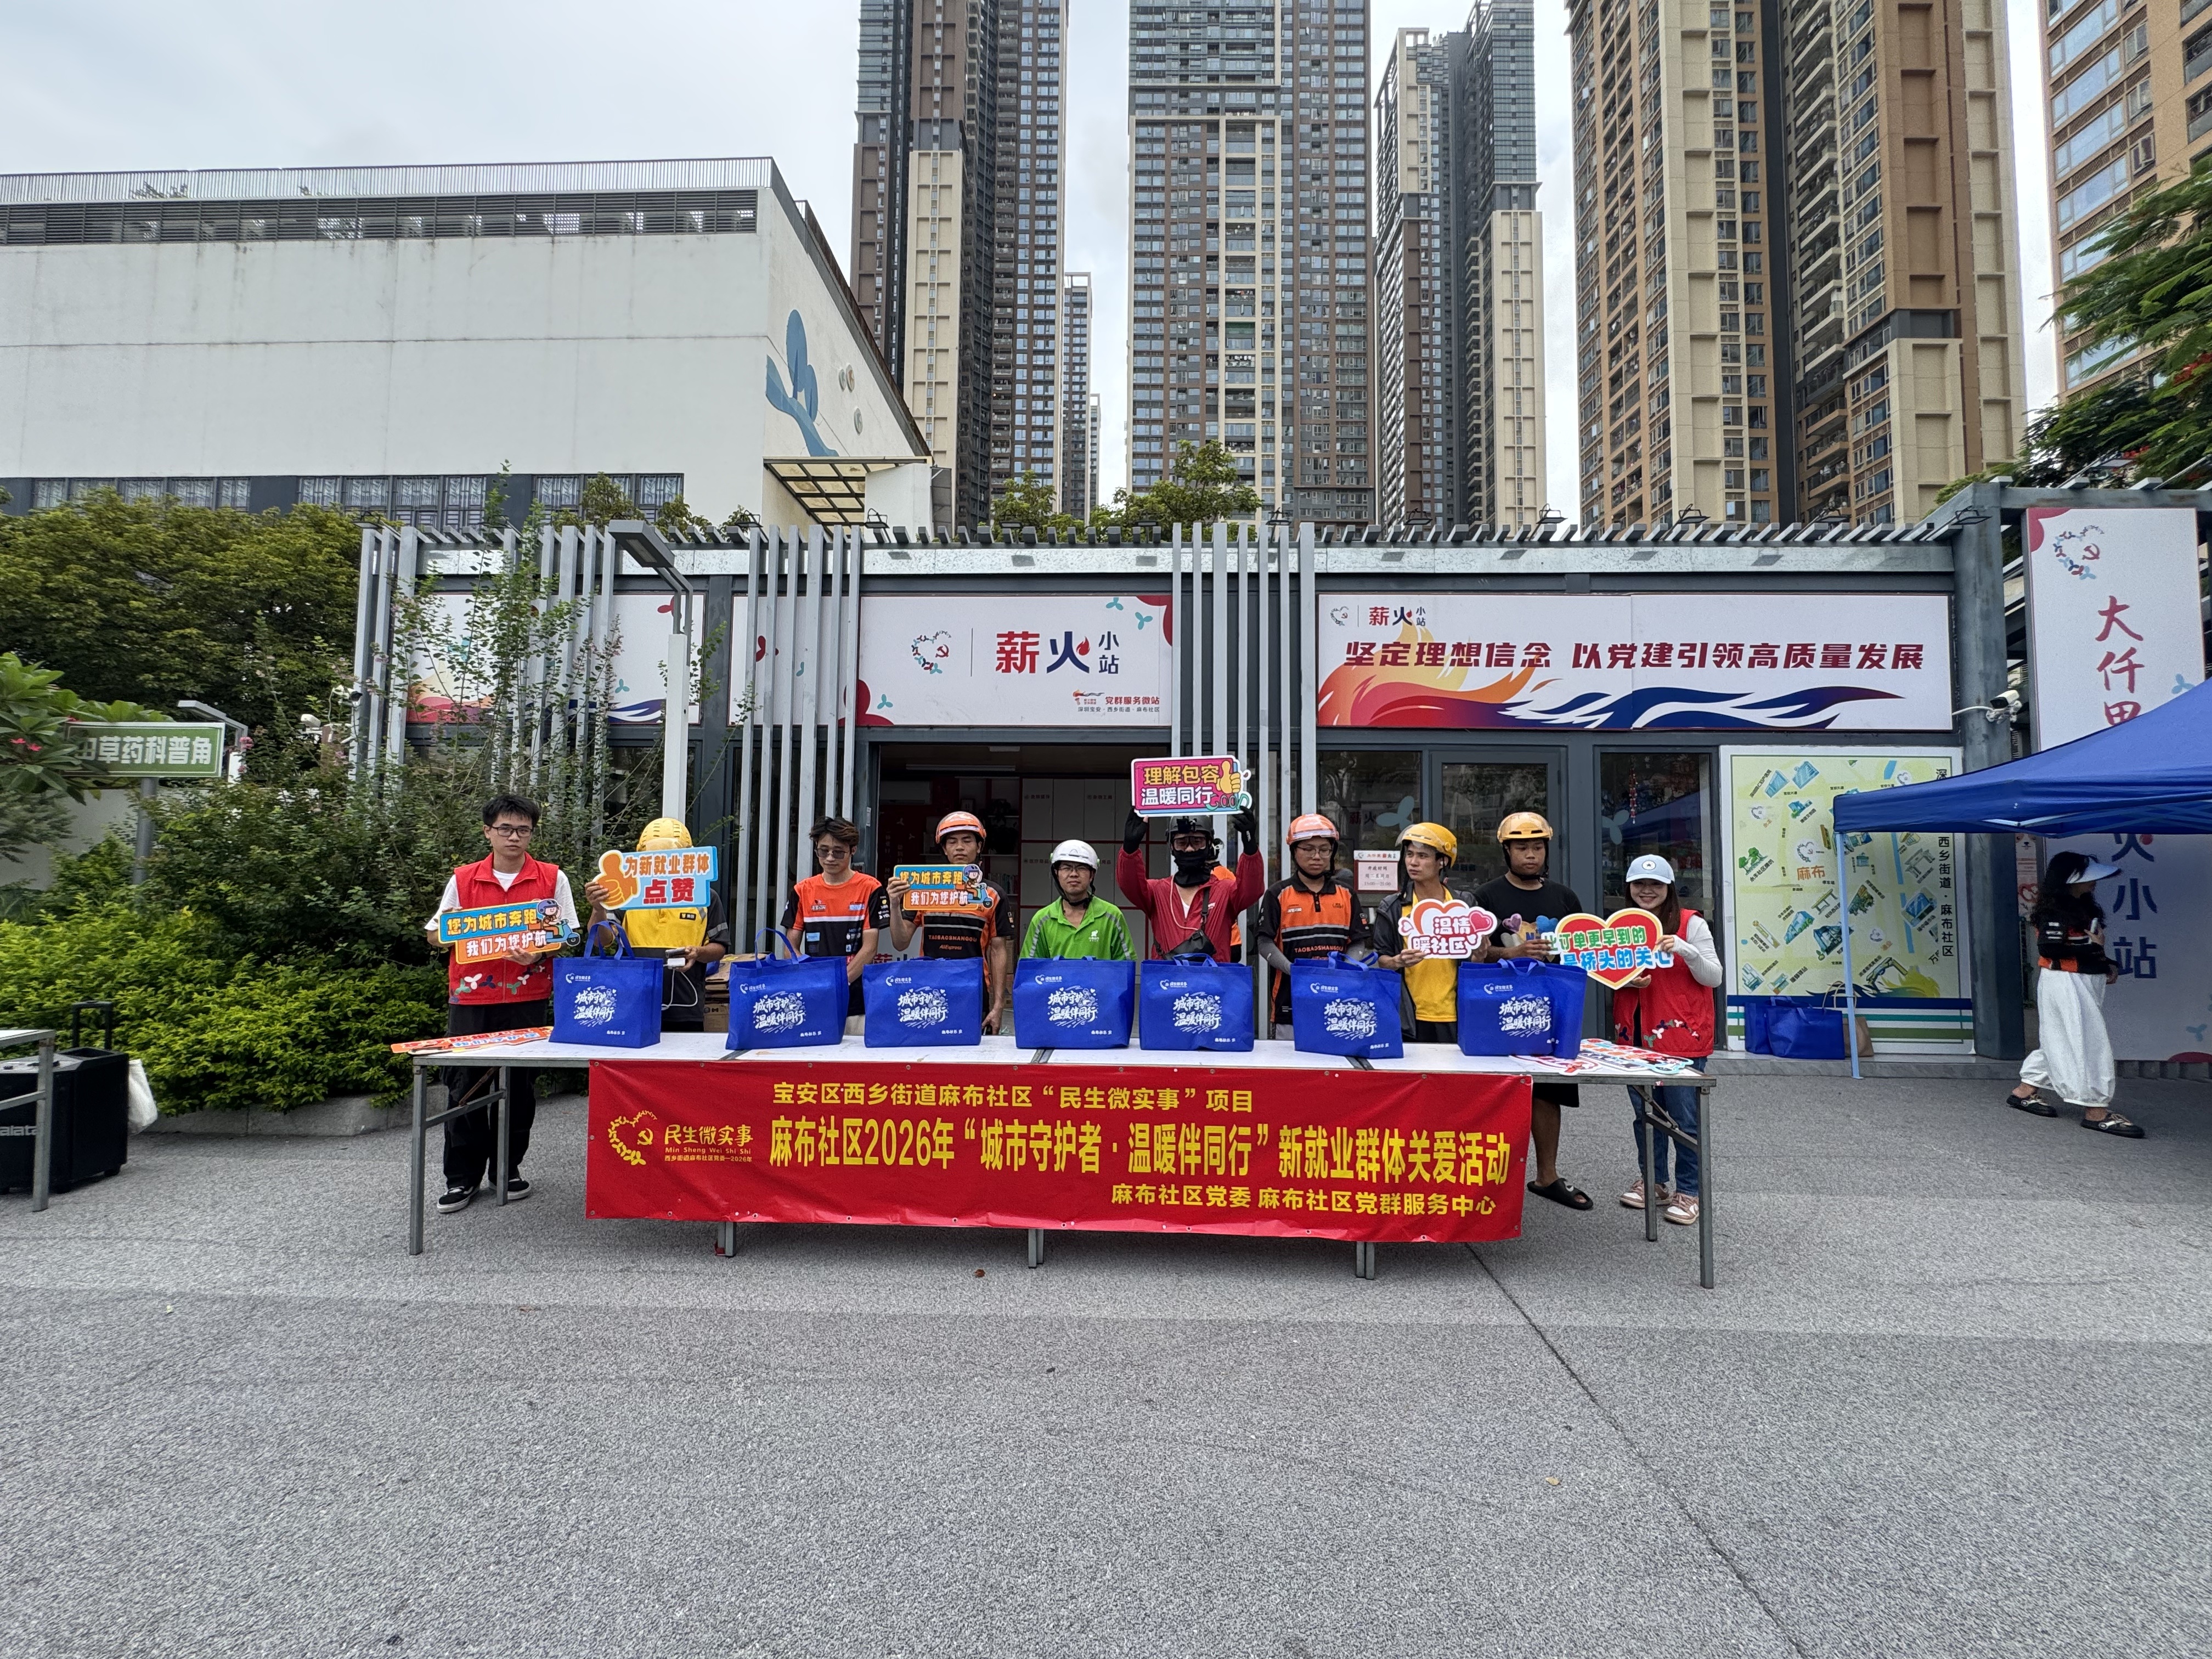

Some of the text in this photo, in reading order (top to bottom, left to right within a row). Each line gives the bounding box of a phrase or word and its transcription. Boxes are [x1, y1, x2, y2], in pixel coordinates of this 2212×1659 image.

[1369, 606, 1413, 626] 薪火
[1416, 606, 1426, 627] 小站
[995, 631, 1091, 674] 薪火
[1098, 631, 1120, 675] 小站
[1344, 641, 1924, 670] 坚定理想信念 以党建引领高质量发展
[1105, 696, 1160, 705] 党群服务微站
[1144, 765, 1219, 785] 理解包容
[1141, 786, 1213, 805] 温暖同行
[624, 853, 710, 878] 为新就业群体
[1797, 865, 1826, 881] 麻布
[900, 871, 963, 885] 您为城市奔跑
[643, 878, 695, 904] 点赞
[911, 890, 968, 906] 我们为您护航
[447, 908, 537, 935] 您为城市奔跑
[1434, 917, 1471, 934] 温情
[466, 930, 547, 958] 我们为您护航
[1413, 936, 1468, 954] 暖社区
[573, 1005, 615, 1022] 温暖伴同行
[753, 1009, 805, 1029] 温暖伴同行
[898, 1006, 948, 1022] 温暖伴同行
[1047, 1005, 1098, 1022] 温暖伴同行
[1172, 1011, 1222, 1030] 温暖伴同行
[1499, 1015, 1552, 1031] 温暖伴同行
[1324, 1017, 1376, 1037] 温暖伴同行
[772, 1082, 1253, 1113] 宝安区西乡街道麻布社区“民生微实事”项目
[664, 1124, 753, 1147] 民生微实事
[769, 1115, 1511, 1186] 麻布社区2026年“城市守护者·温暖伴同行”新就业群体关爱活动
[1111, 1183, 1497, 1217] 麻布社区党委 麻布社区党群服务中心
